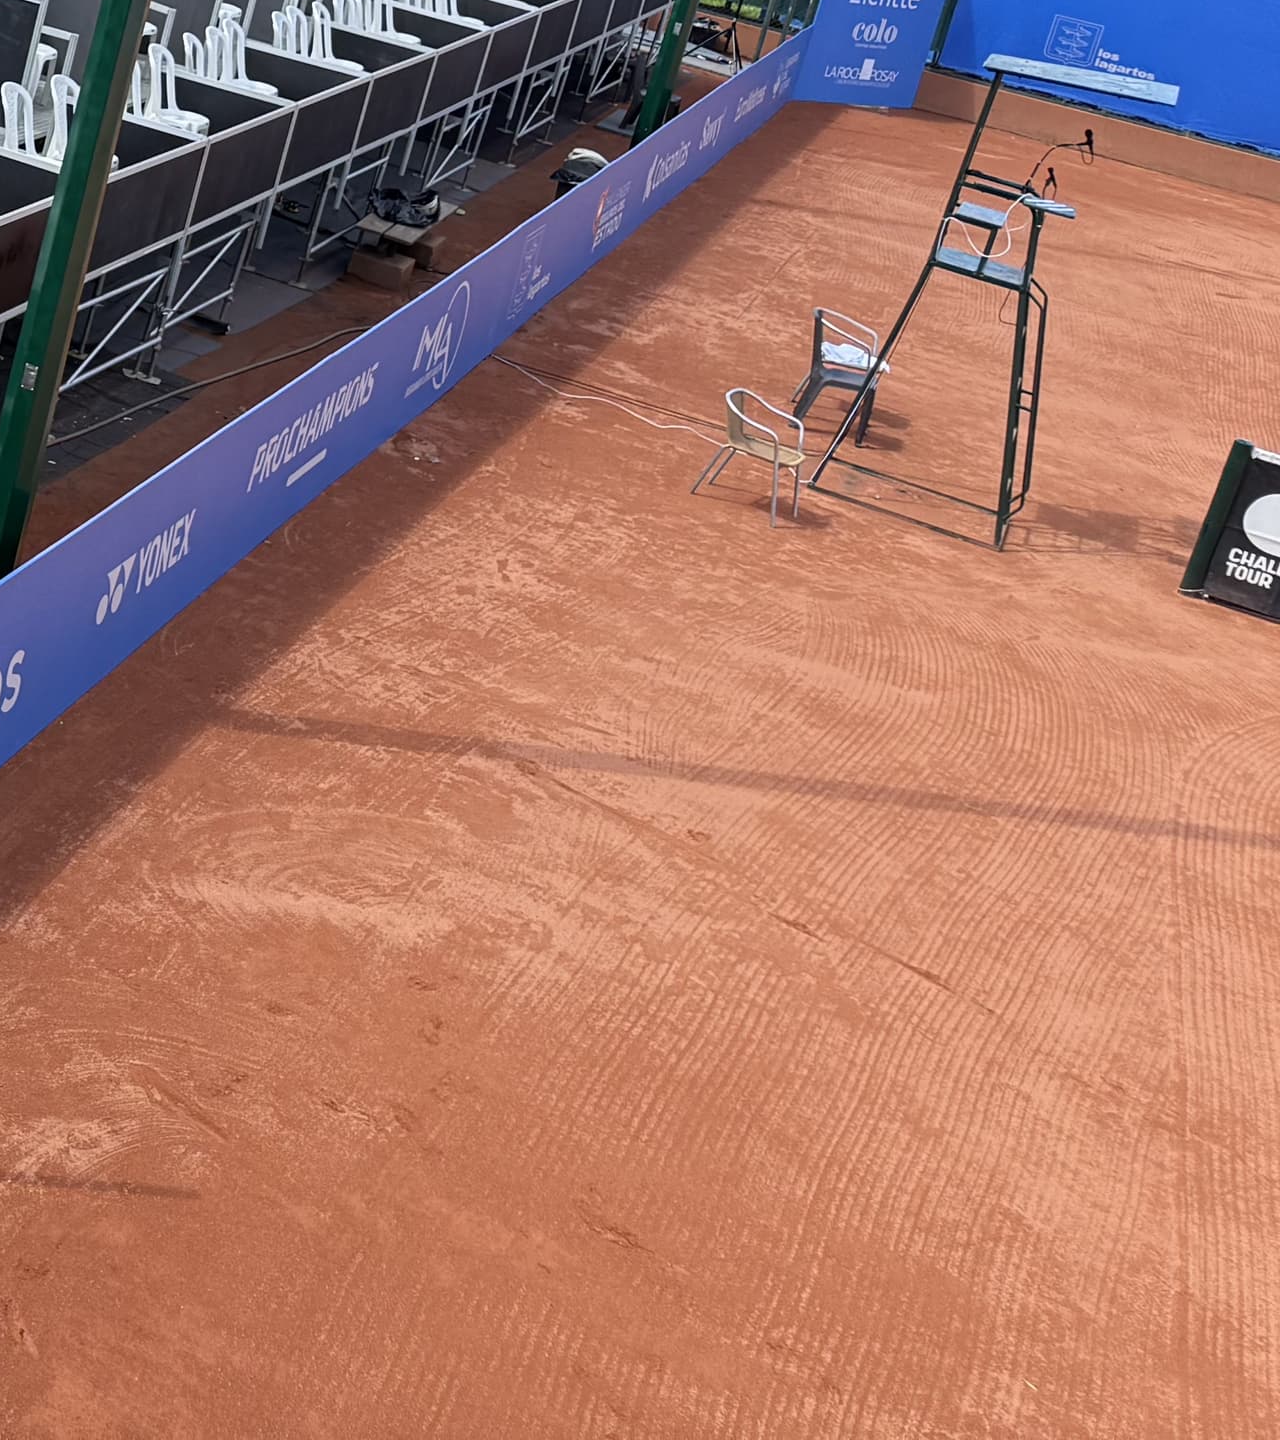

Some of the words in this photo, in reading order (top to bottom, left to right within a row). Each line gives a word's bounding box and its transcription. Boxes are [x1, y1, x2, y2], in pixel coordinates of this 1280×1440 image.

[852, 18, 898, 44] colo
[1098, 48, 1120, 61] los
[1094, 58, 1155, 81] lagartos
[247, 362, 379, 493] PROCHAMPIONS
[136, 508, 196, 594] YONEX
[1225, 561, 1274, 590] TOUR
